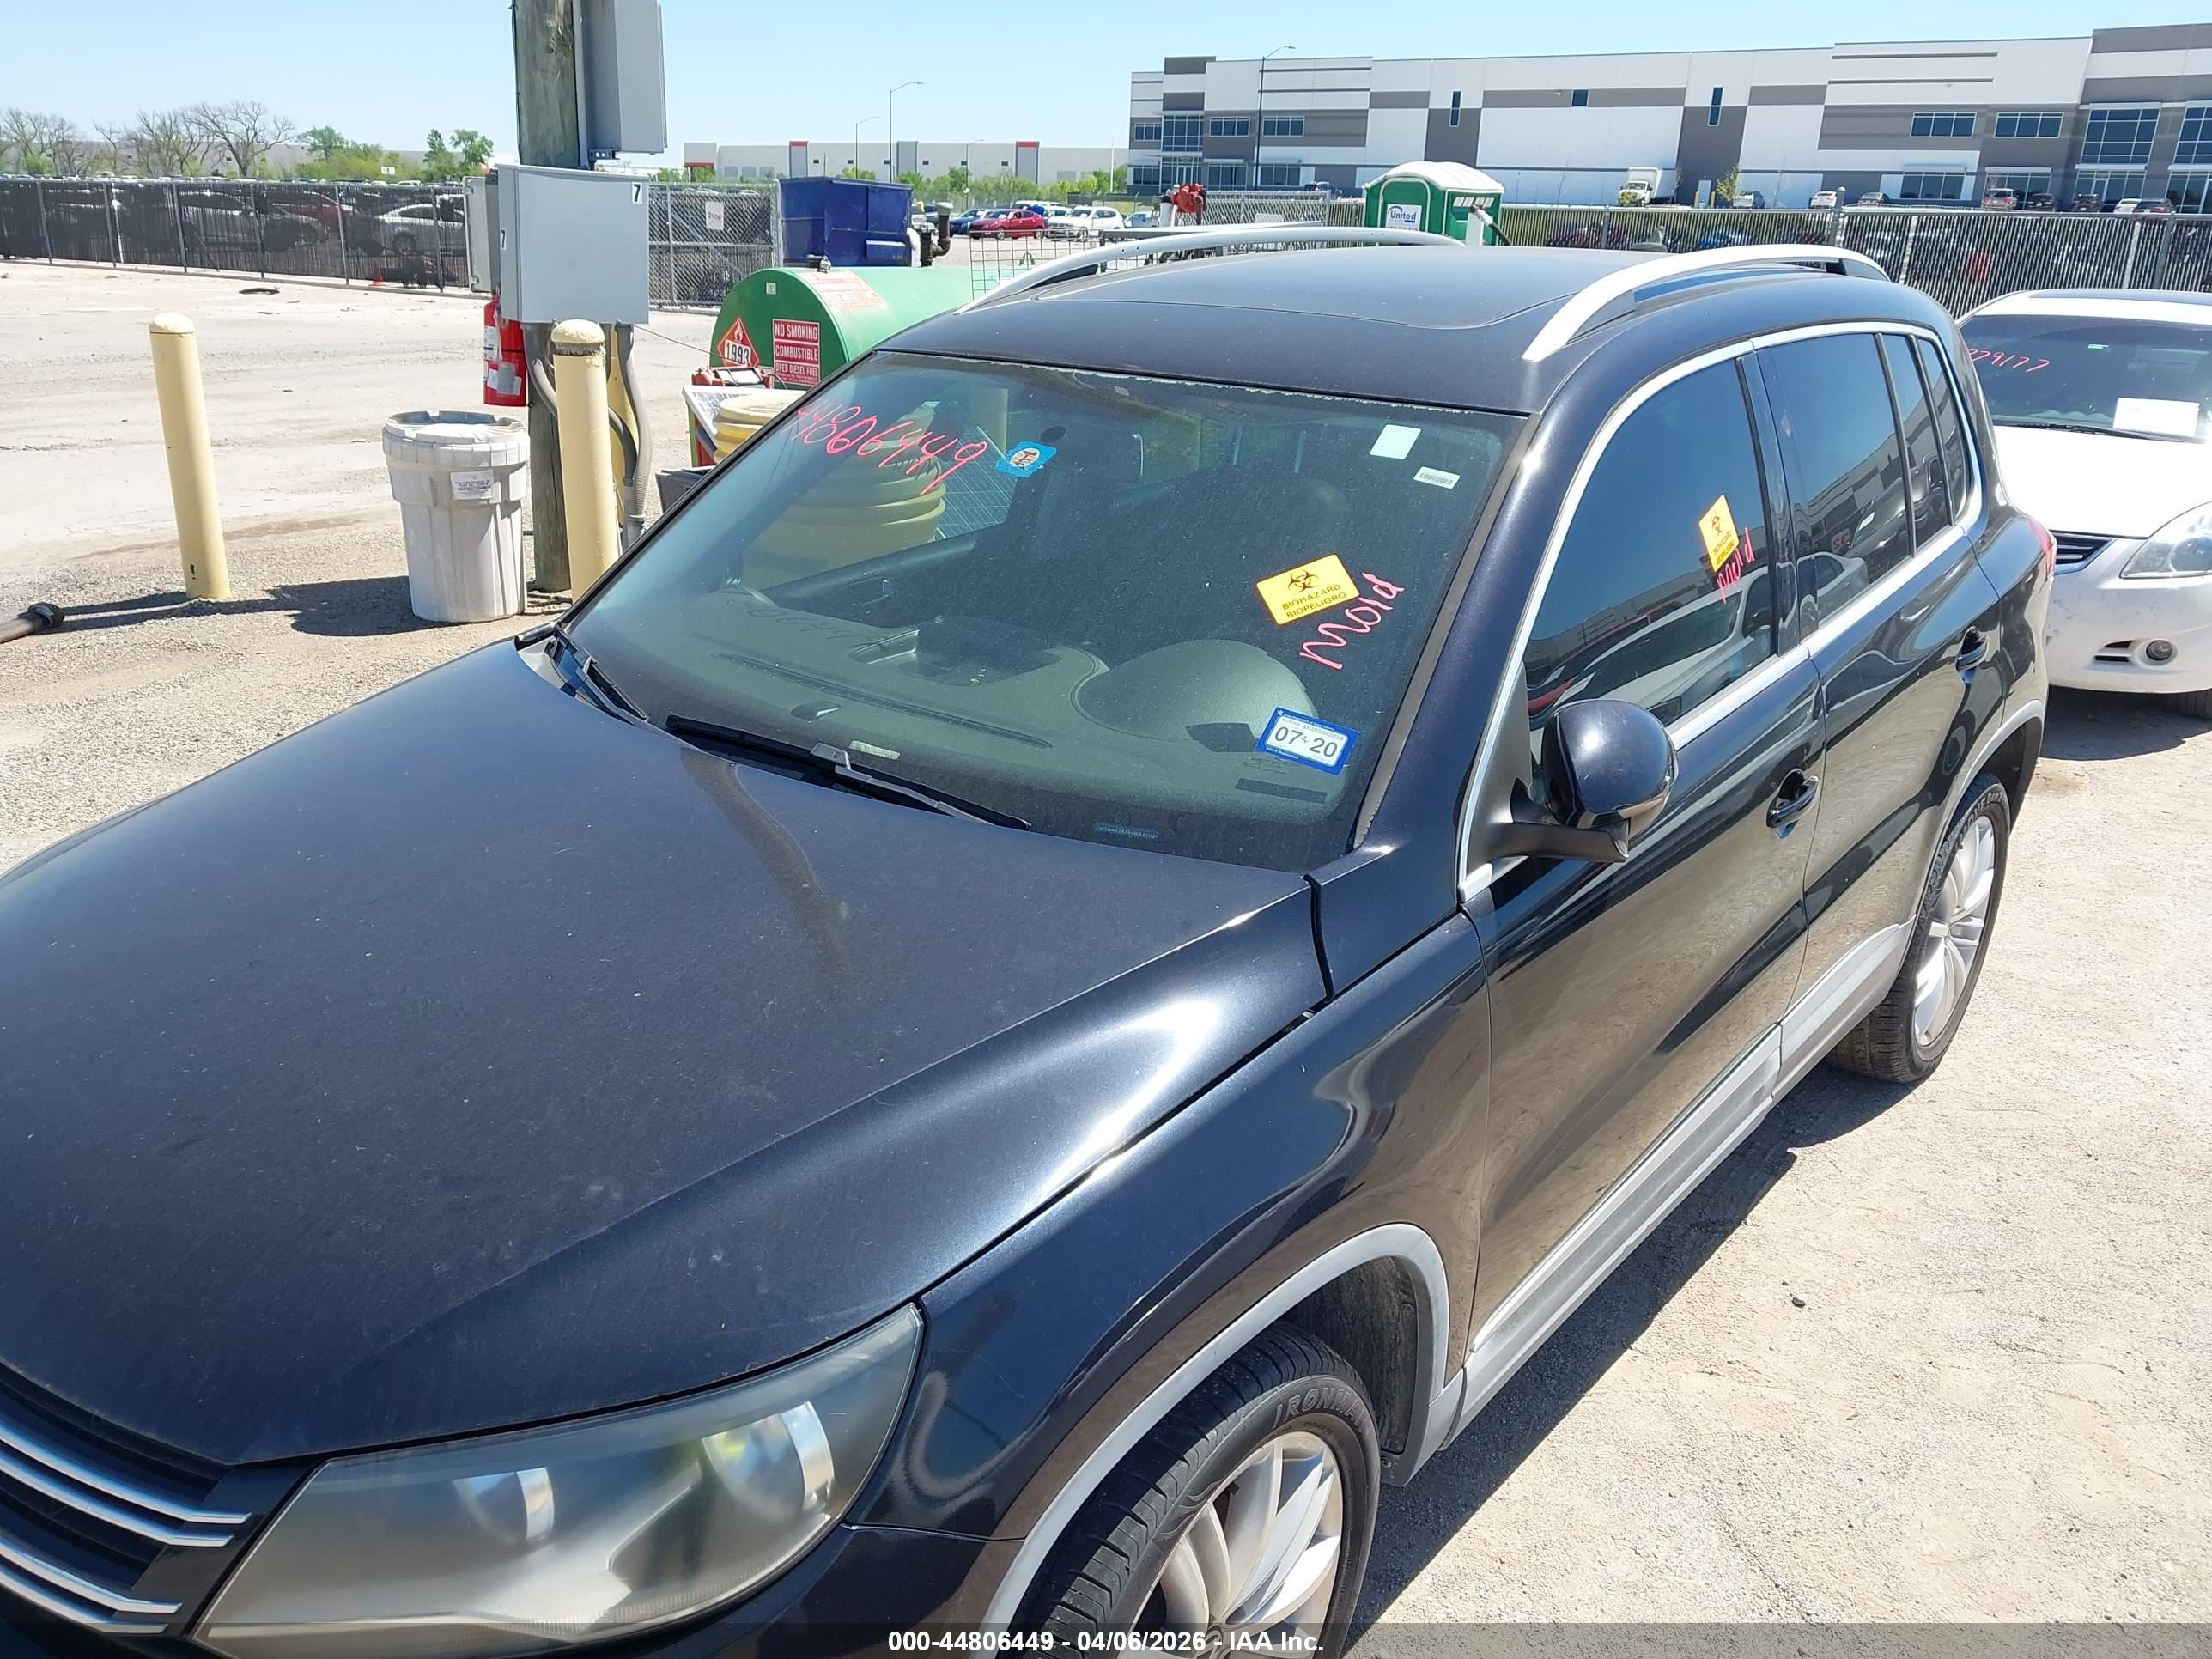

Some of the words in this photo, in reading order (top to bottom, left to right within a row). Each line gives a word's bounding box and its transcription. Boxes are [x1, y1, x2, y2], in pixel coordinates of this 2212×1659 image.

[634, 183, 641, 202] 7
[1390, 210, 1417, 220] United
[775, 323, 785, 337] NO
[786, 325, 818, 340] SMOKING
[775, 345, 818, 361] COMBUSTIBLE
[1281, 583, 1341, 611] BIOHAZARD
[1286, 591, 1346, 618] BIOPELIGRO
[1274, 726, 1304, 744] 07
[1309, 738, 1338, 757] 20
